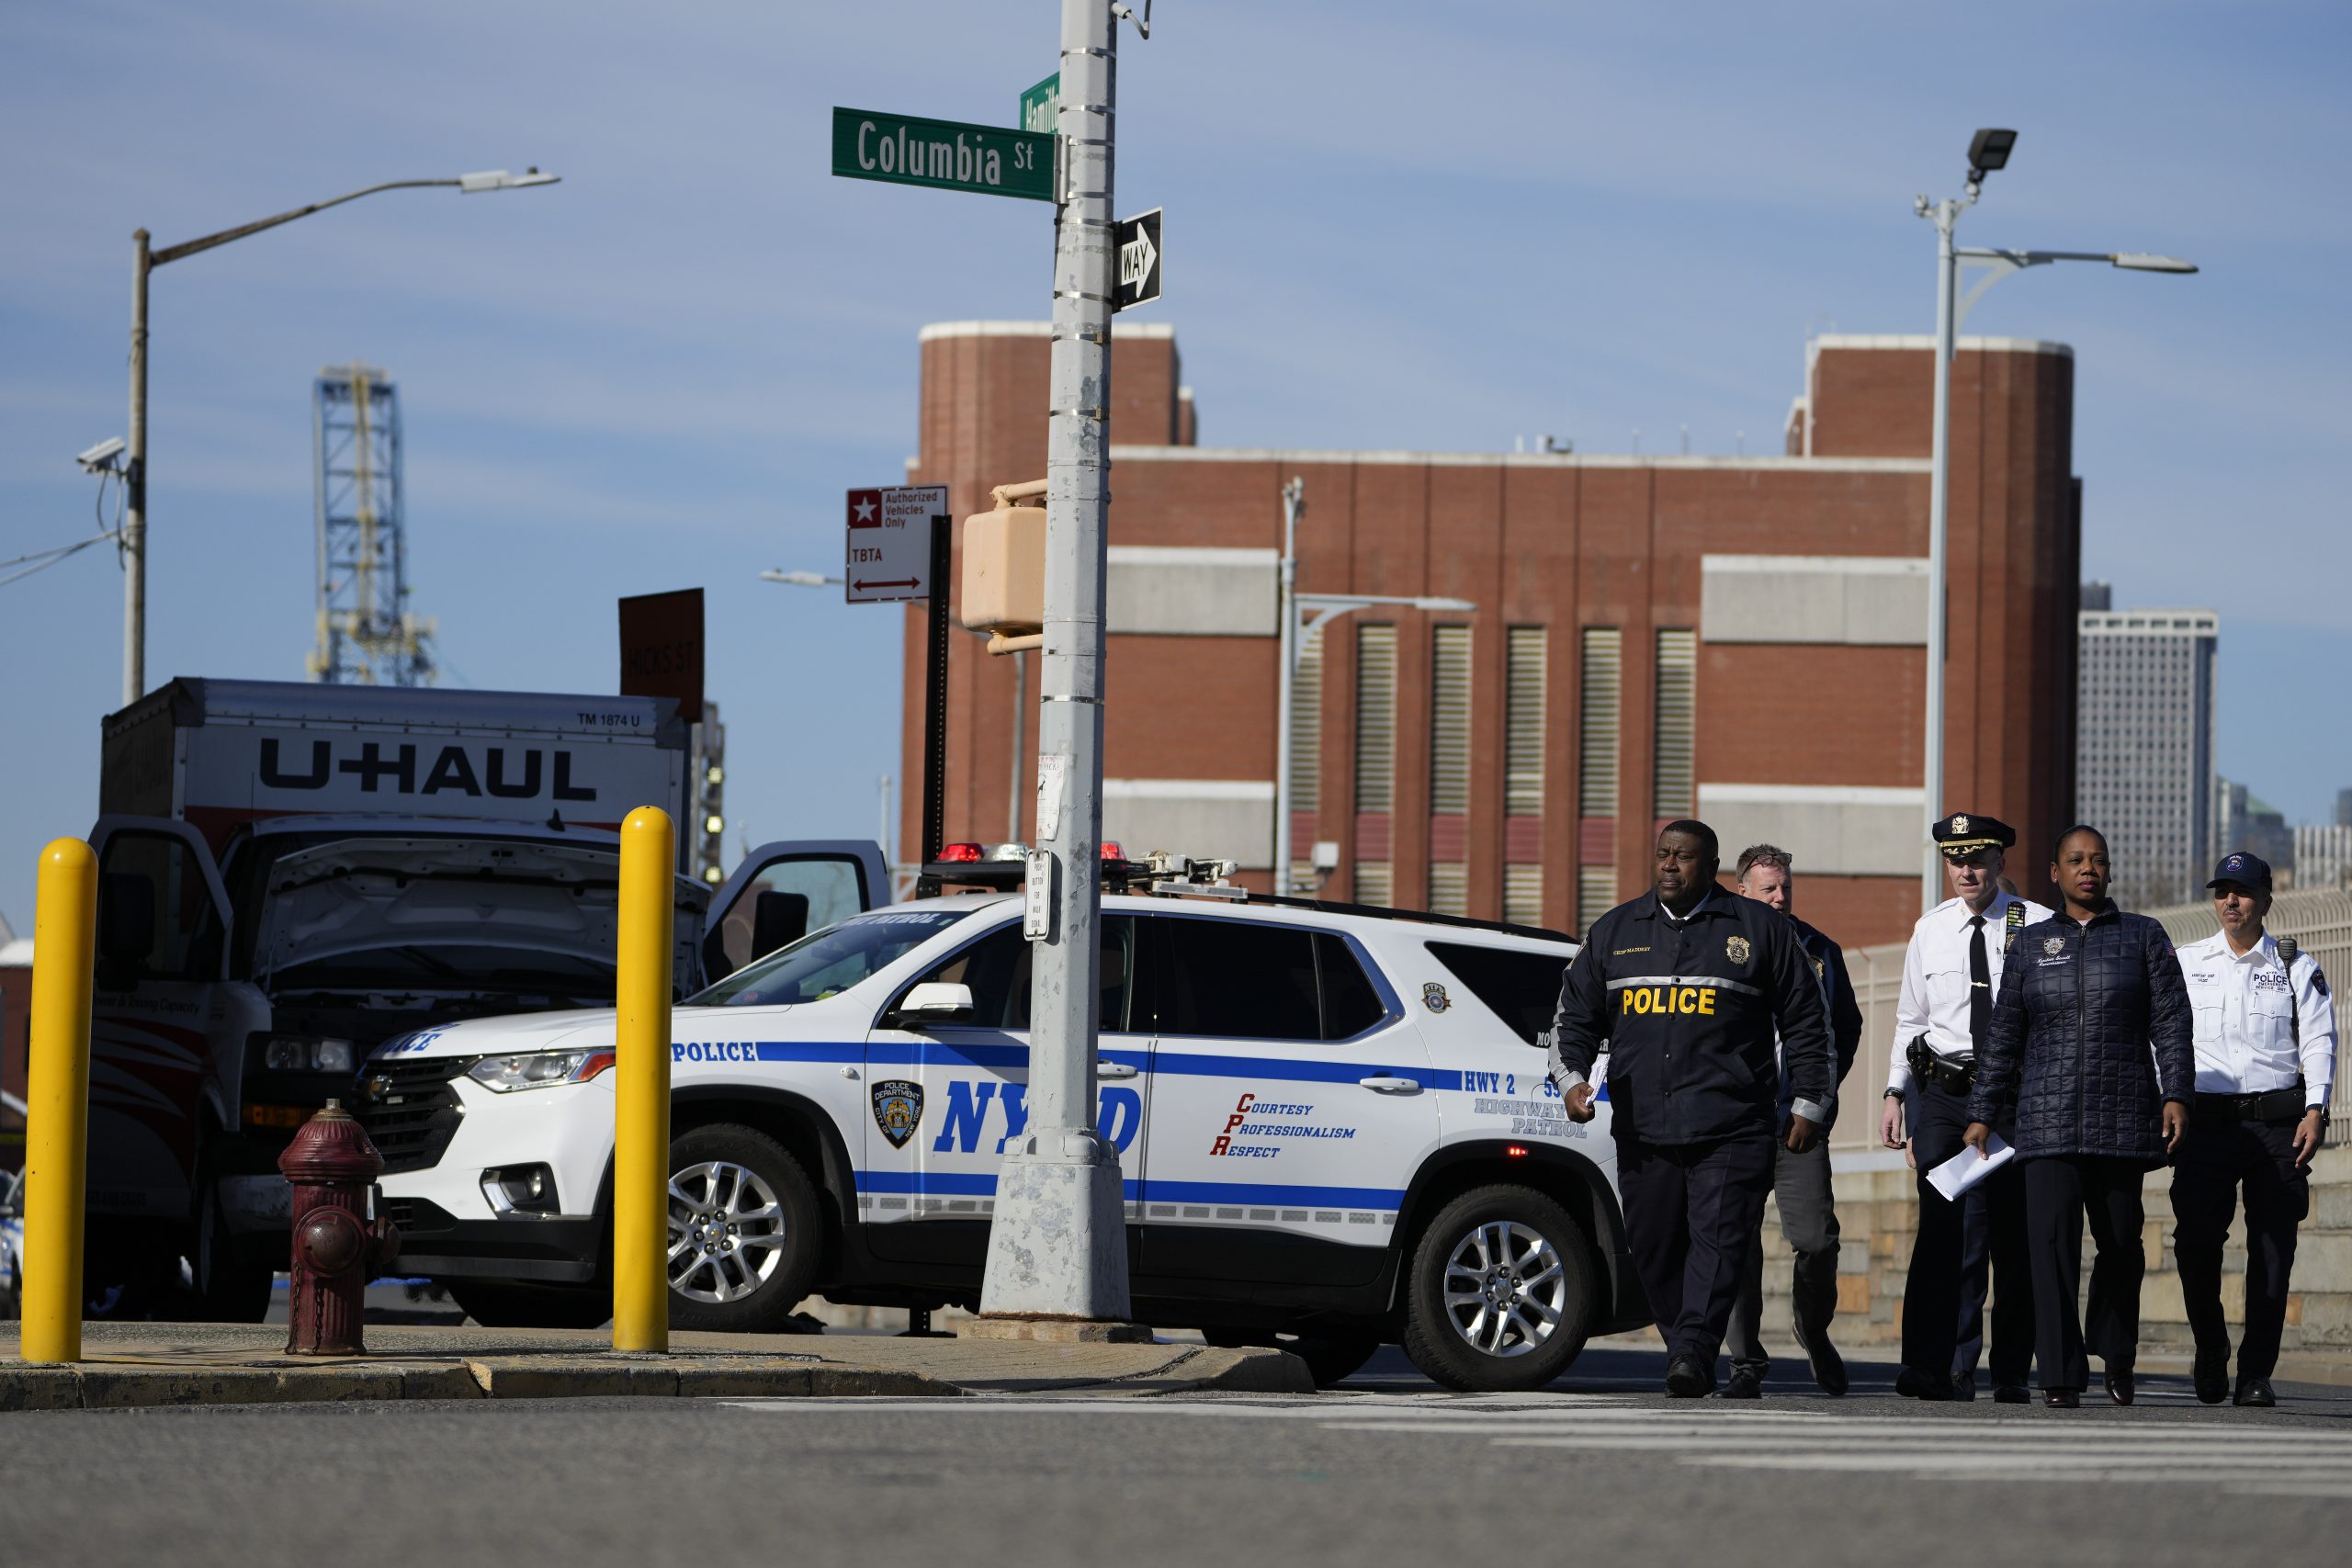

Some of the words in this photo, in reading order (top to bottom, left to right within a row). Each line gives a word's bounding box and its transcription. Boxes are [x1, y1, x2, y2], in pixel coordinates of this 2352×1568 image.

[1026, 84, 1058, 133] Hamilto
[858, 121, 1001, 186] Columbia
[1014, 141, 1034, 170] St
[1123, 242, 1148, 280] WAY
[886, 491, 937, 503] Authorized
[885, 505, 924, 515] Vehicles
[885, 517, 906, 529] Only
[853, 548, 882, 562] TBTA
[577, 713, 596, 725] TM
[601, 714, 628, 727] 1874
[631, 715, 640, 727] U
[2254, 974, 2288, 986] POLICE
[93, 995, 118, 1009] ower
[1623, 987, 1716, 1015] POLICE
[671, 1042, 755, 1062] POLICE
[884, 1082, 910, 1090] POLICE
[1464, 1070, 1499, 1093] HWY
[1506, 1073, 1516, 1095] 2
[875, 1089, 921, 1100] DEPARTMENT
[1237, 1093, 1314, 1115] COURTESY
[933, 1080, 1142, 1156] NYD
[1475, 1099, 1567, 1119] HIGHWAY
[875, 1107, 885, 1123] CITY
[882, 1125, 890, 1135] OF
[912, 1105, 922, 1122] YORK
[1223, 1114, 1356, 1139] PROFESSIONALISM
[1510, 1118, 1588, 1139] PATROL
[1209, 1135, 1281, 1157] RESPECT
